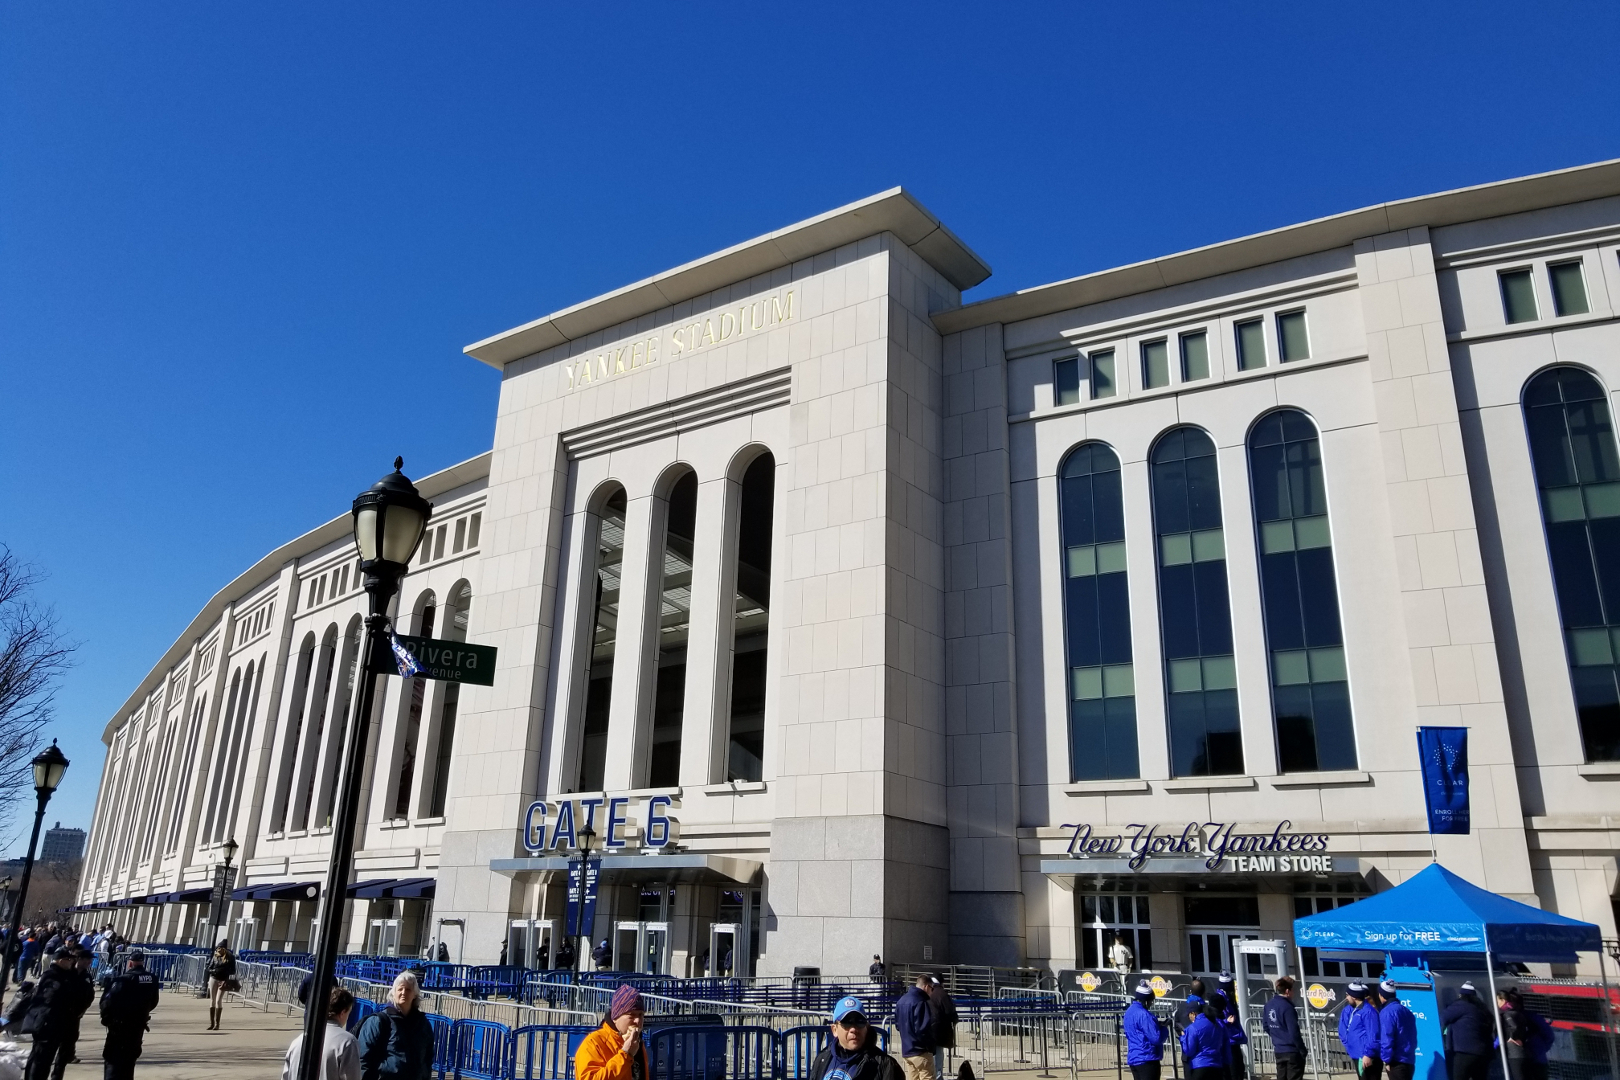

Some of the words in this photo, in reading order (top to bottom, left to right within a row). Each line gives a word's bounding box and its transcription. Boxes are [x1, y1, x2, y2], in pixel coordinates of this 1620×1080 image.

[566, 336, 659, 391] YANKEE
[671, 290, 794, 357] STADIUM
[405, 641, 478, 668] Rivera
[426, 667, 461, 679] enue
[523, 797, 629, 851] GATE
[645, 795, 672, 848] 6
[1059, 823, 1122, 854] New
[1125, 821, 1199, 870] York
[1200, 819, 1330, 869] Yankees
[1230, 856, 1276, 872] TEAM
[1280, 855, 1332, 872] STORE
[1399, 931, 1413, 941] for
[1415, 931, 1441, 941] FREE
[1075, 975, 1089, 985] Hard
[1088, 977, 1101, 986] Rock
[1317, 989, 1336, 1001] Rock
